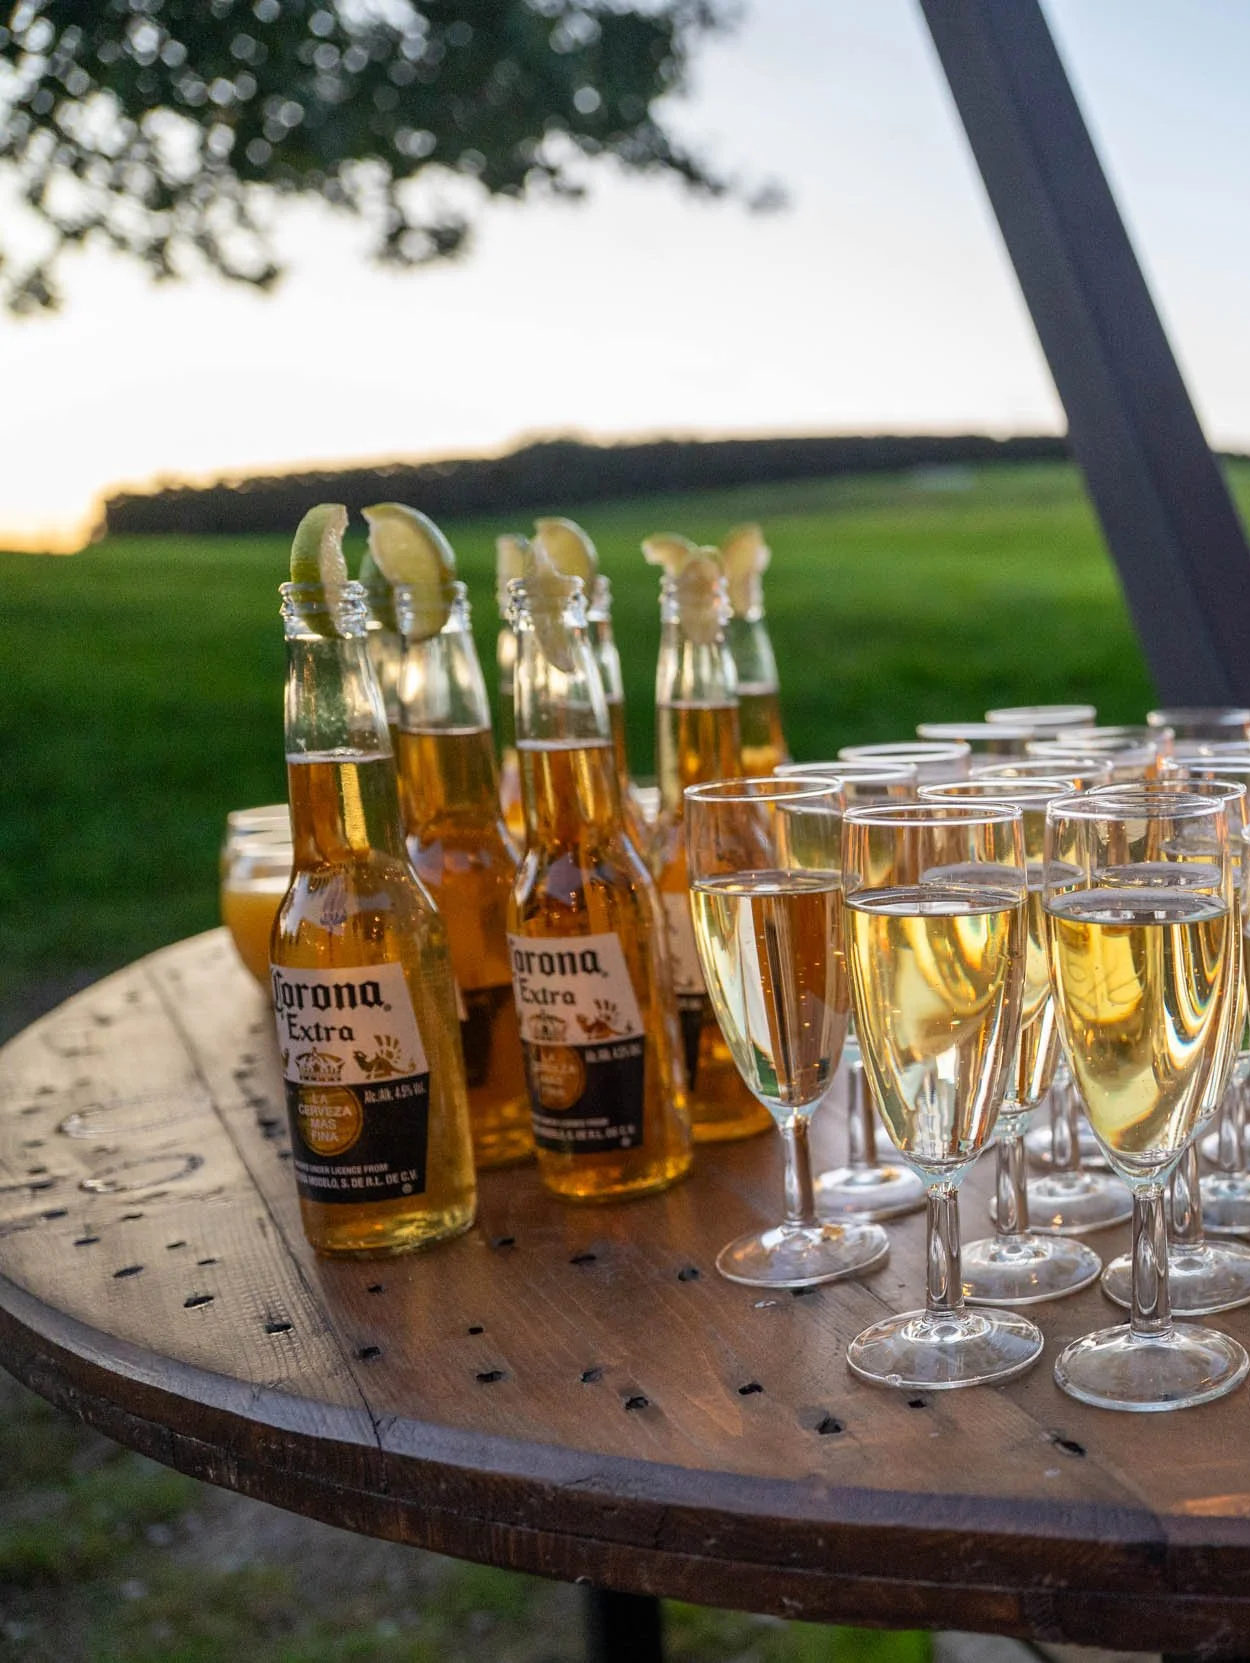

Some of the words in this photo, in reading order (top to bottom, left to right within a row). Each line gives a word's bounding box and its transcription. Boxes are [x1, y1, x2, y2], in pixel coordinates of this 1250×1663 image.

[272, 969, 384, 1013] Corona
[286, 1012, 355, 1042] Extra
[312, 1093, 328, 1105] LA
[298, 1104, 352, 1117] CERVEZA
[310, 1118, 337, 1130] MAS
[311, 1130, 339, 1142] FINA
[363, 1163, 388, 1173] FROM
[385, 1173, 400, 1185] DE
